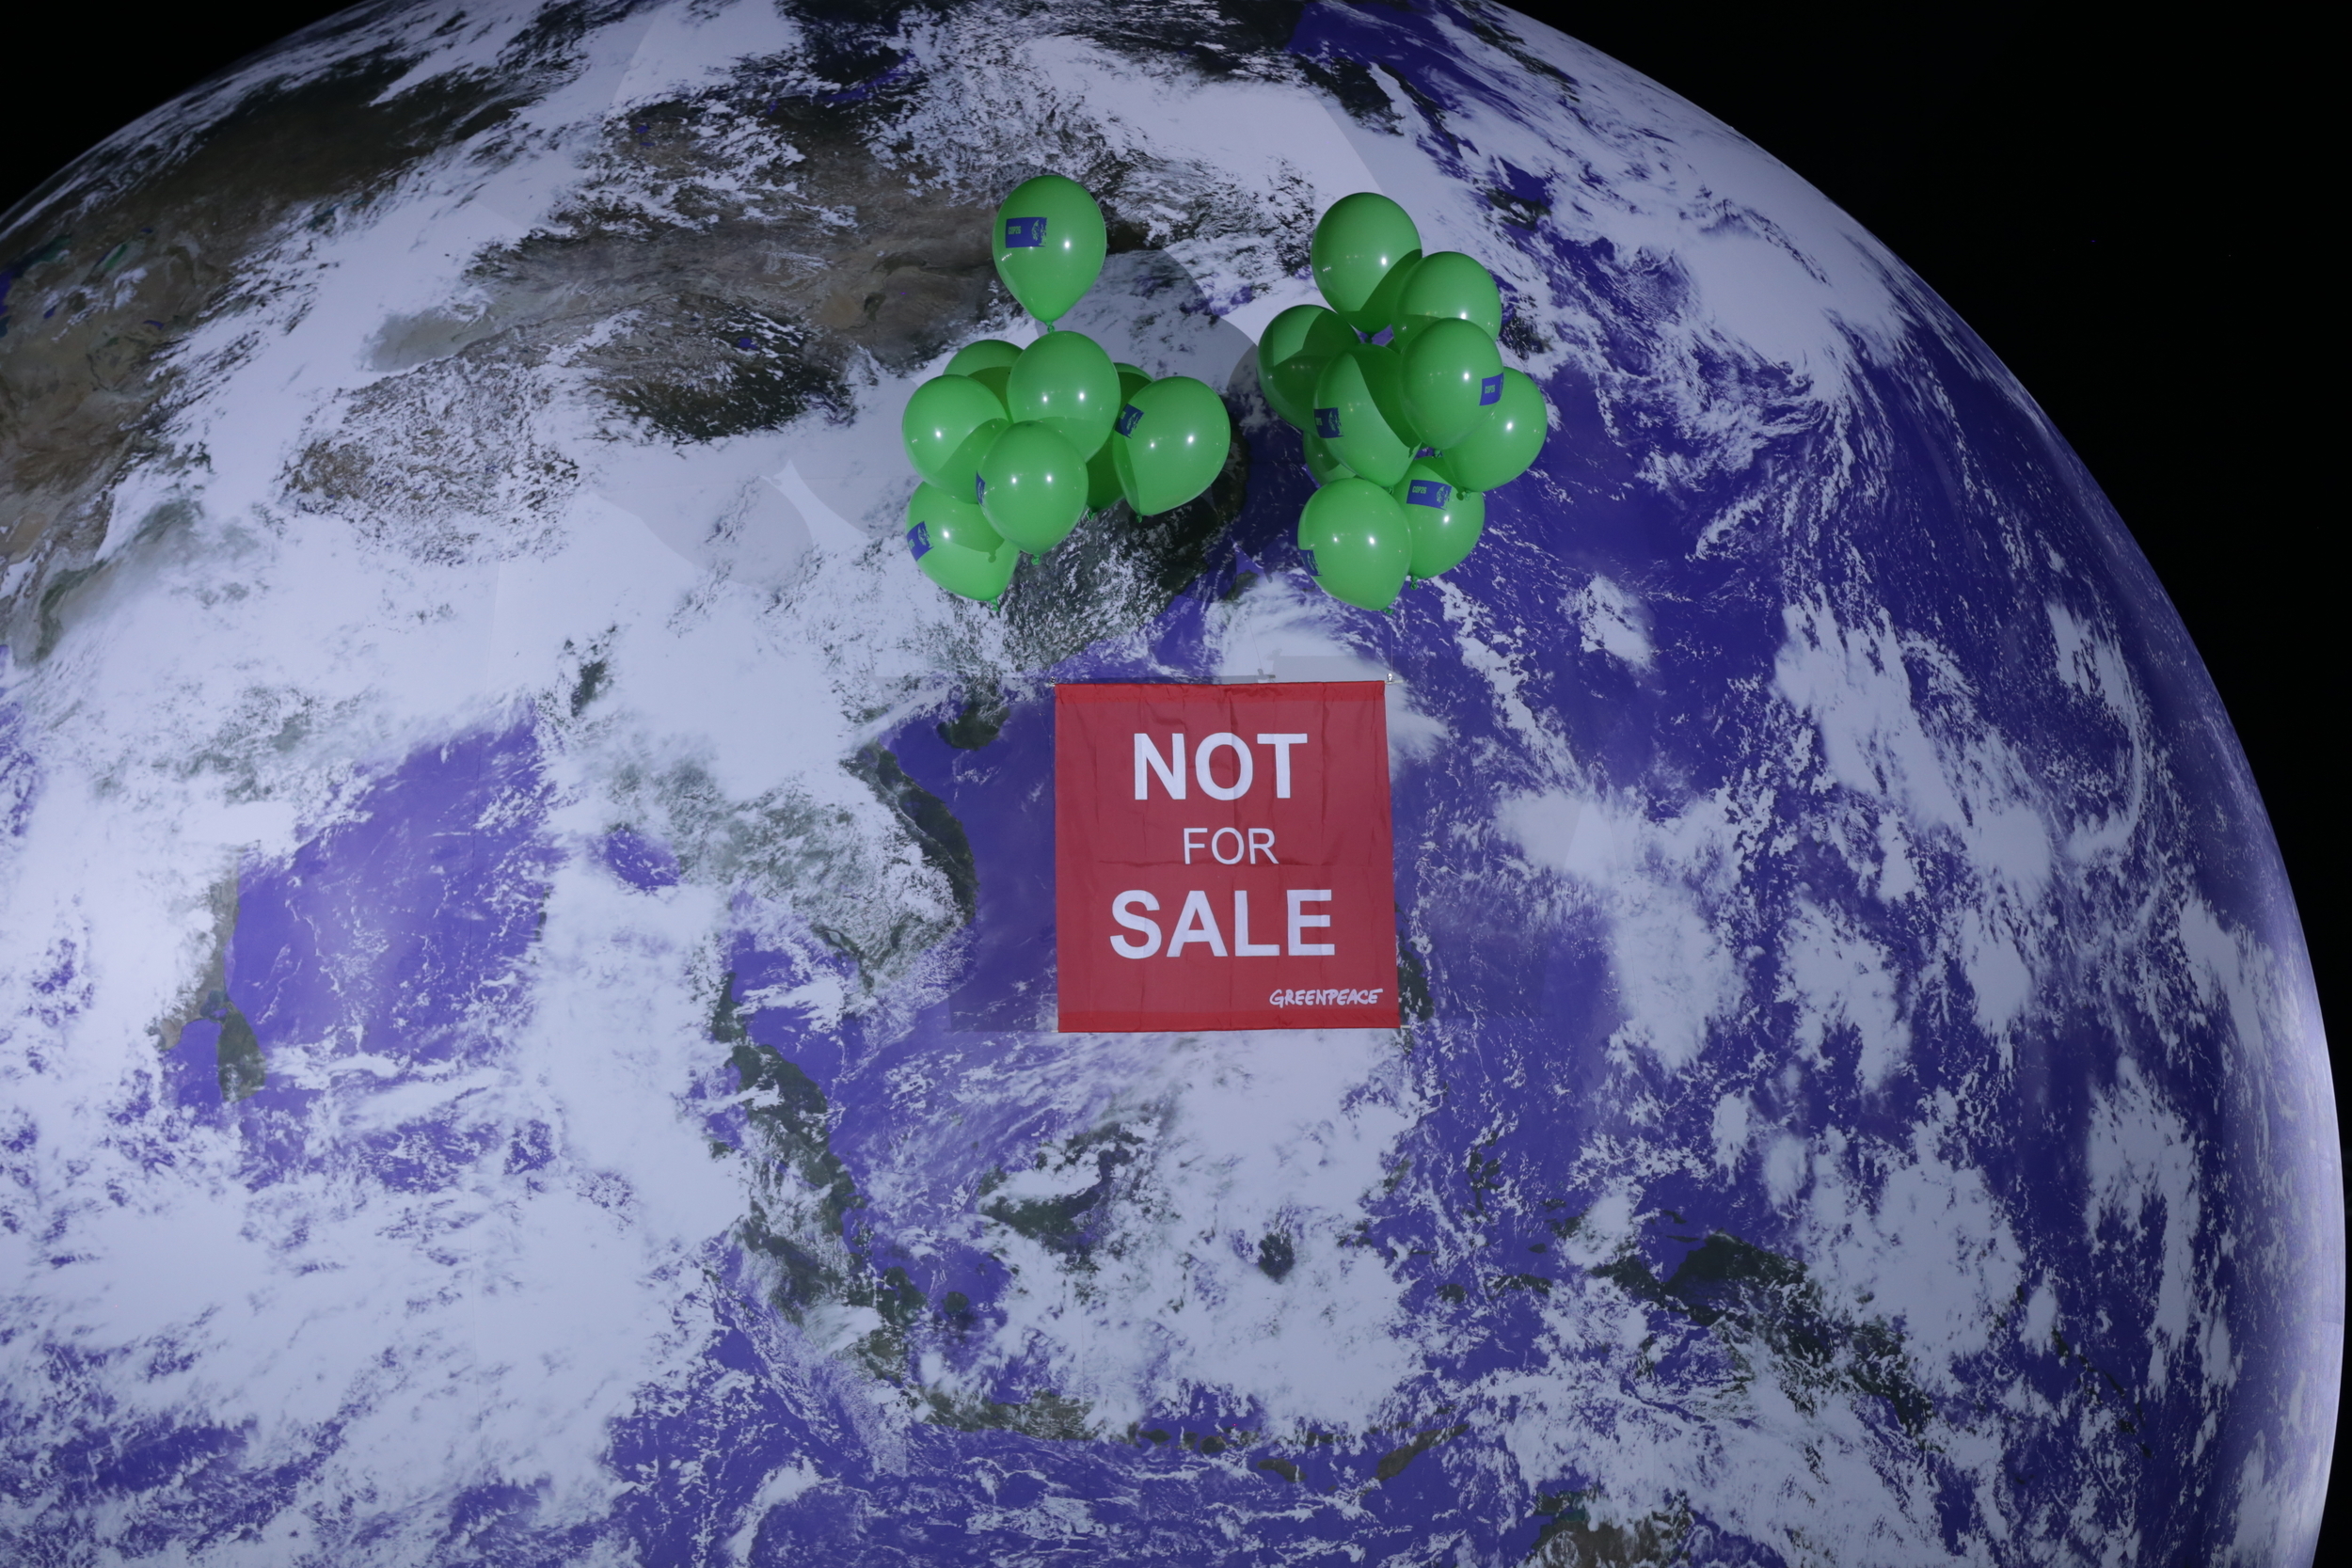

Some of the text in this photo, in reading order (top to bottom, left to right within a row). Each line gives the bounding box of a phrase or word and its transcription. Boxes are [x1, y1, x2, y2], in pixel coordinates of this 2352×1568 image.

[1412, 485, 1427, 494] COP26
[1134, 732, 1309, 800] NOT
[1183, 827, 1279, 865] FOR
[1109, 889, 1336, 959] SALE
[1269, 988, 1384, 1008] GREENPEACE
